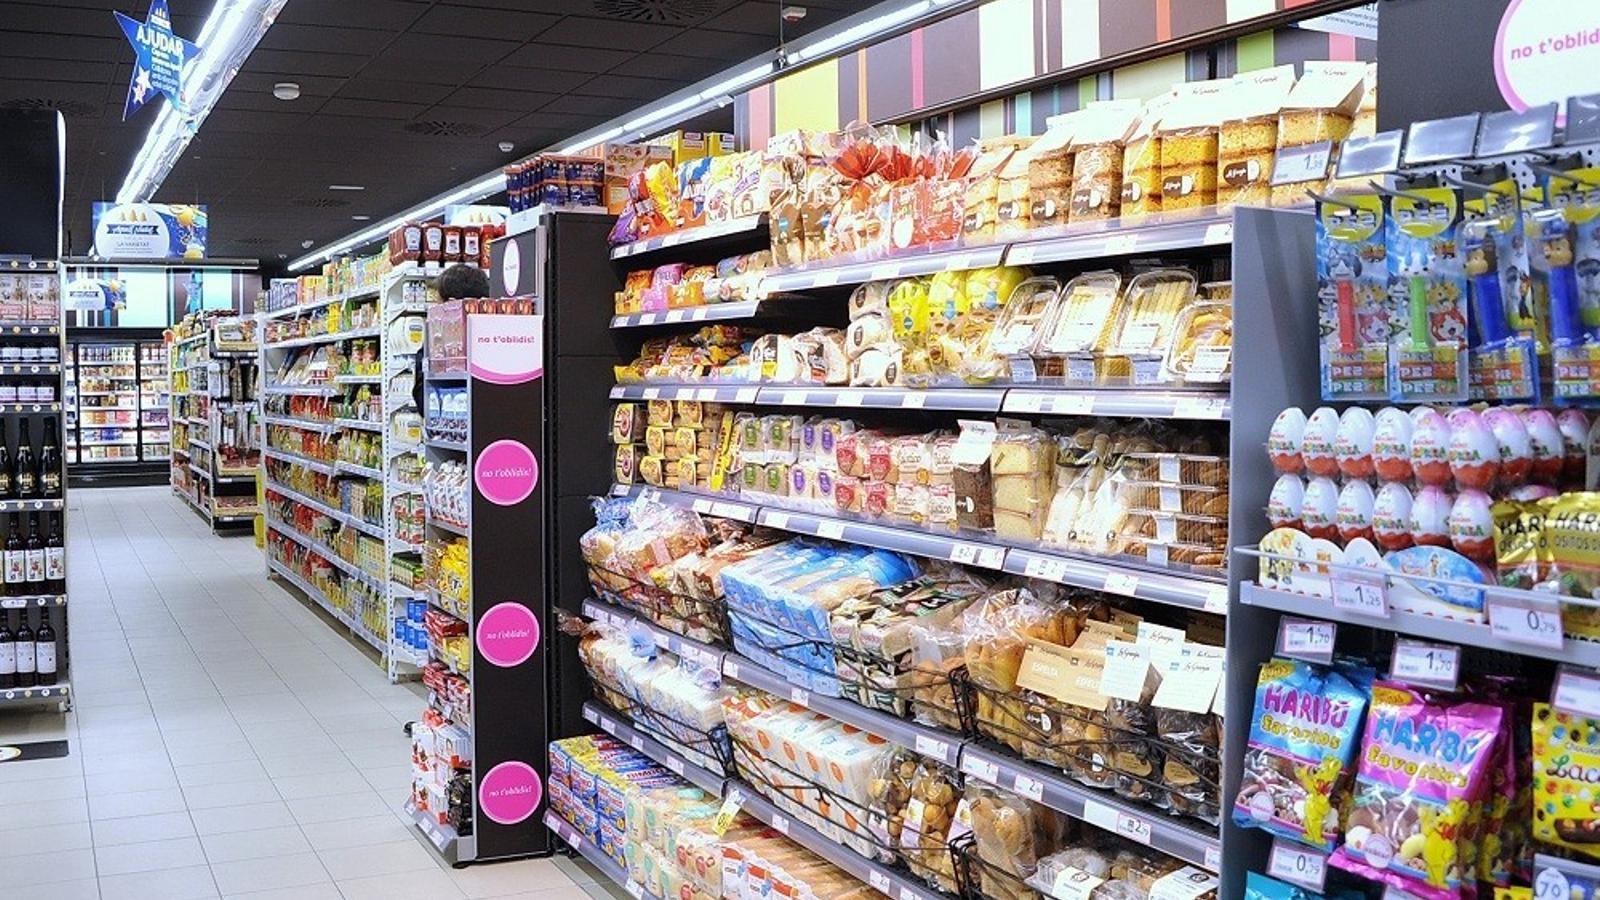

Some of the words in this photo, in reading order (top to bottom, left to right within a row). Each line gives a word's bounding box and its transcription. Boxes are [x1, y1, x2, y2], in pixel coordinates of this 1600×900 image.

[136, 24, 184, 58] AJUDAR
[1511, 46, 1533, 60] no
[493, 335, 535, 344] t'oblidis!
[1332, 365, 1363, 377] PEZ
[1400, 365, 1432, 377] PEZ
[1559, 366, 1589, 378] PEZ
[1333, 382, 1362, 392] PEZ
[1403, 382, 1434, 393] PEZ
[1559, 384, 1589, 395] PEZ
[481, 470, 493, 478] no
[1355, 585, 1382, 606] 1,25
[1306, 626, 1330, 644] 1,70
[1263, 684, 1348, 728] HARIBO
[1374, 711, 1480, 765] HARBO
